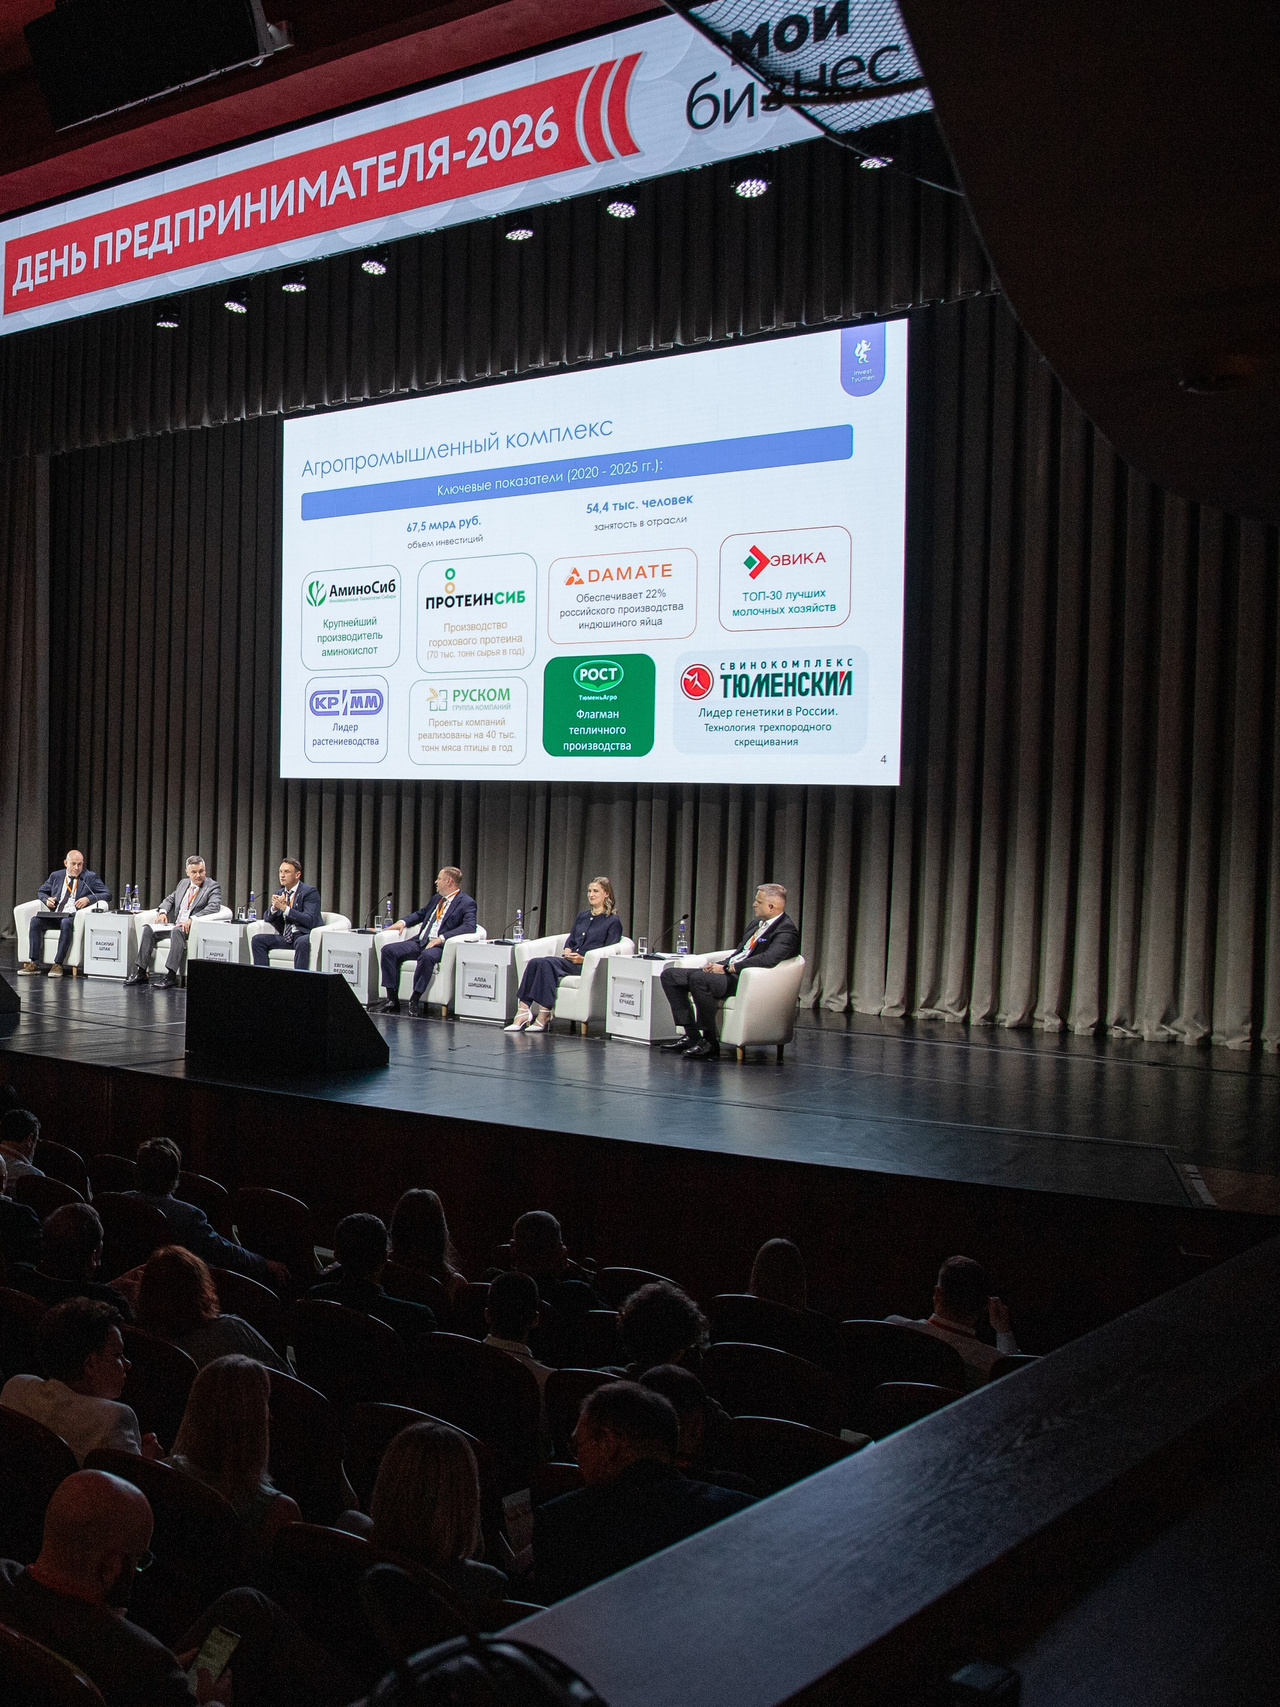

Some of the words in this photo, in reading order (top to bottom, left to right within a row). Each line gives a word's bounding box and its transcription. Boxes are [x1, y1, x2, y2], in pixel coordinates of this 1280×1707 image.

[11, 249, 87, 296] ДЕНЬ
[93, 106, 560, 270] ПРЕДПРИНИМАТЕЛЯ-2026
[301, 432, 499, 478] Агропромышленный
[506, 420, 613, 450] комплекс
[437, 482, 492, 497] Ключевые
[495, 472, 563, 490] показатели
[567, 466, 599, 483] (2020
[609, 461, 639, 476] 2025
[641, 458, 664, 474] гг.):
[586, 502, 610, 514] 54,4
[612, 501, 639, 512] тыс.
[642, 494, 694, 509] человек
[406, 521, 427, 533] 67,5
[429, 519, 457, 532] млрд
[459, 514, 481, 530] руб.
[593, 521, 638, 532] занятость
[646, 515, 688, 527] отрасли
[407, 540, 434, 550] объем
[435, 533, 484, 547] инвестиций
[770, 551, 827, 567] ЭВИКА
[588, 563, 673, 583] DAMATE
[329, 579, 396, 597] АминоСиб
[425, 590, 526, 610] ПРОТЕИНСИБ
[576, 592, 643, 603] Обеспечивает
[645, 588, 667, 599] 22%
[742, 590, 783, 602] ТОП-30
[785, 589, 826, 602] лучших
[560, 606, 616, 619] российского
[618, 602, 684, 616] производства
[732, 606, 785, 617] молочных
[788, 602, 837, 614] хозяйств
[323, 615, 378, 631] Крупнейший
[443, 621, 508, 634] Производство
[578, 619, 638, 630] индюшиного
[640, 616, 663, 628] яйца
[317, 631, 384, 645] производитель
[428, 637, 478, 649] горохового
[480, 634, 523, 646] протеина
[321, 645, 379, 657] аминокислот
[426, 650, 439, 661] (70
[440, 650, 456, 659] тыс.
[458, 649, 475, 658] тонн
[477, 648, 501, 658] сырья
[508, 646, 525, 657] год)
[720, 658, 854, 671] СВИНОКОМПЛЕКС
[580, 667, 618, 681] РОСТ
[452, 687, 511, 702] РУСКОМ
[579, 694, 618, 702] ТюменьАгро
[452, 703, 474, 711] ГРУППА
[475, 702, 512, 711] КОМПАНИЙ
[698, 707, 732, 719] Лидер
[735, 707, 784, 719] генетики
[795, 705, 838, 717] России.
[576, 709, 620, 720] Флагман
[332, 722, 359, 733] Лидер
[428, 717, 463, 728] Проекты
[465, 716, 506, 727] компаний
[704, 723, 756, 733] Технология
[759, 722, 832, 734] трехпородного
[418, 732, 472, 742] реализованы
[473, 732, 484, 740] на
[486, 729, 497, 740] 40
[499, 730, 516, 740] тыс.
[569, 726, 627, 735] тепличного
[312, 737, 380, 747] растениеводства
[421, 744, 440, 753] тонн
[441, 744, 462, 753] мяса
[463, 744, 489, 754] птицы
[498, 743, 513, 754] год
[563, 742, 632, 753] производства
[734, 737, 799, 748] скрещивания
[880, 754, 887, 764] 4
